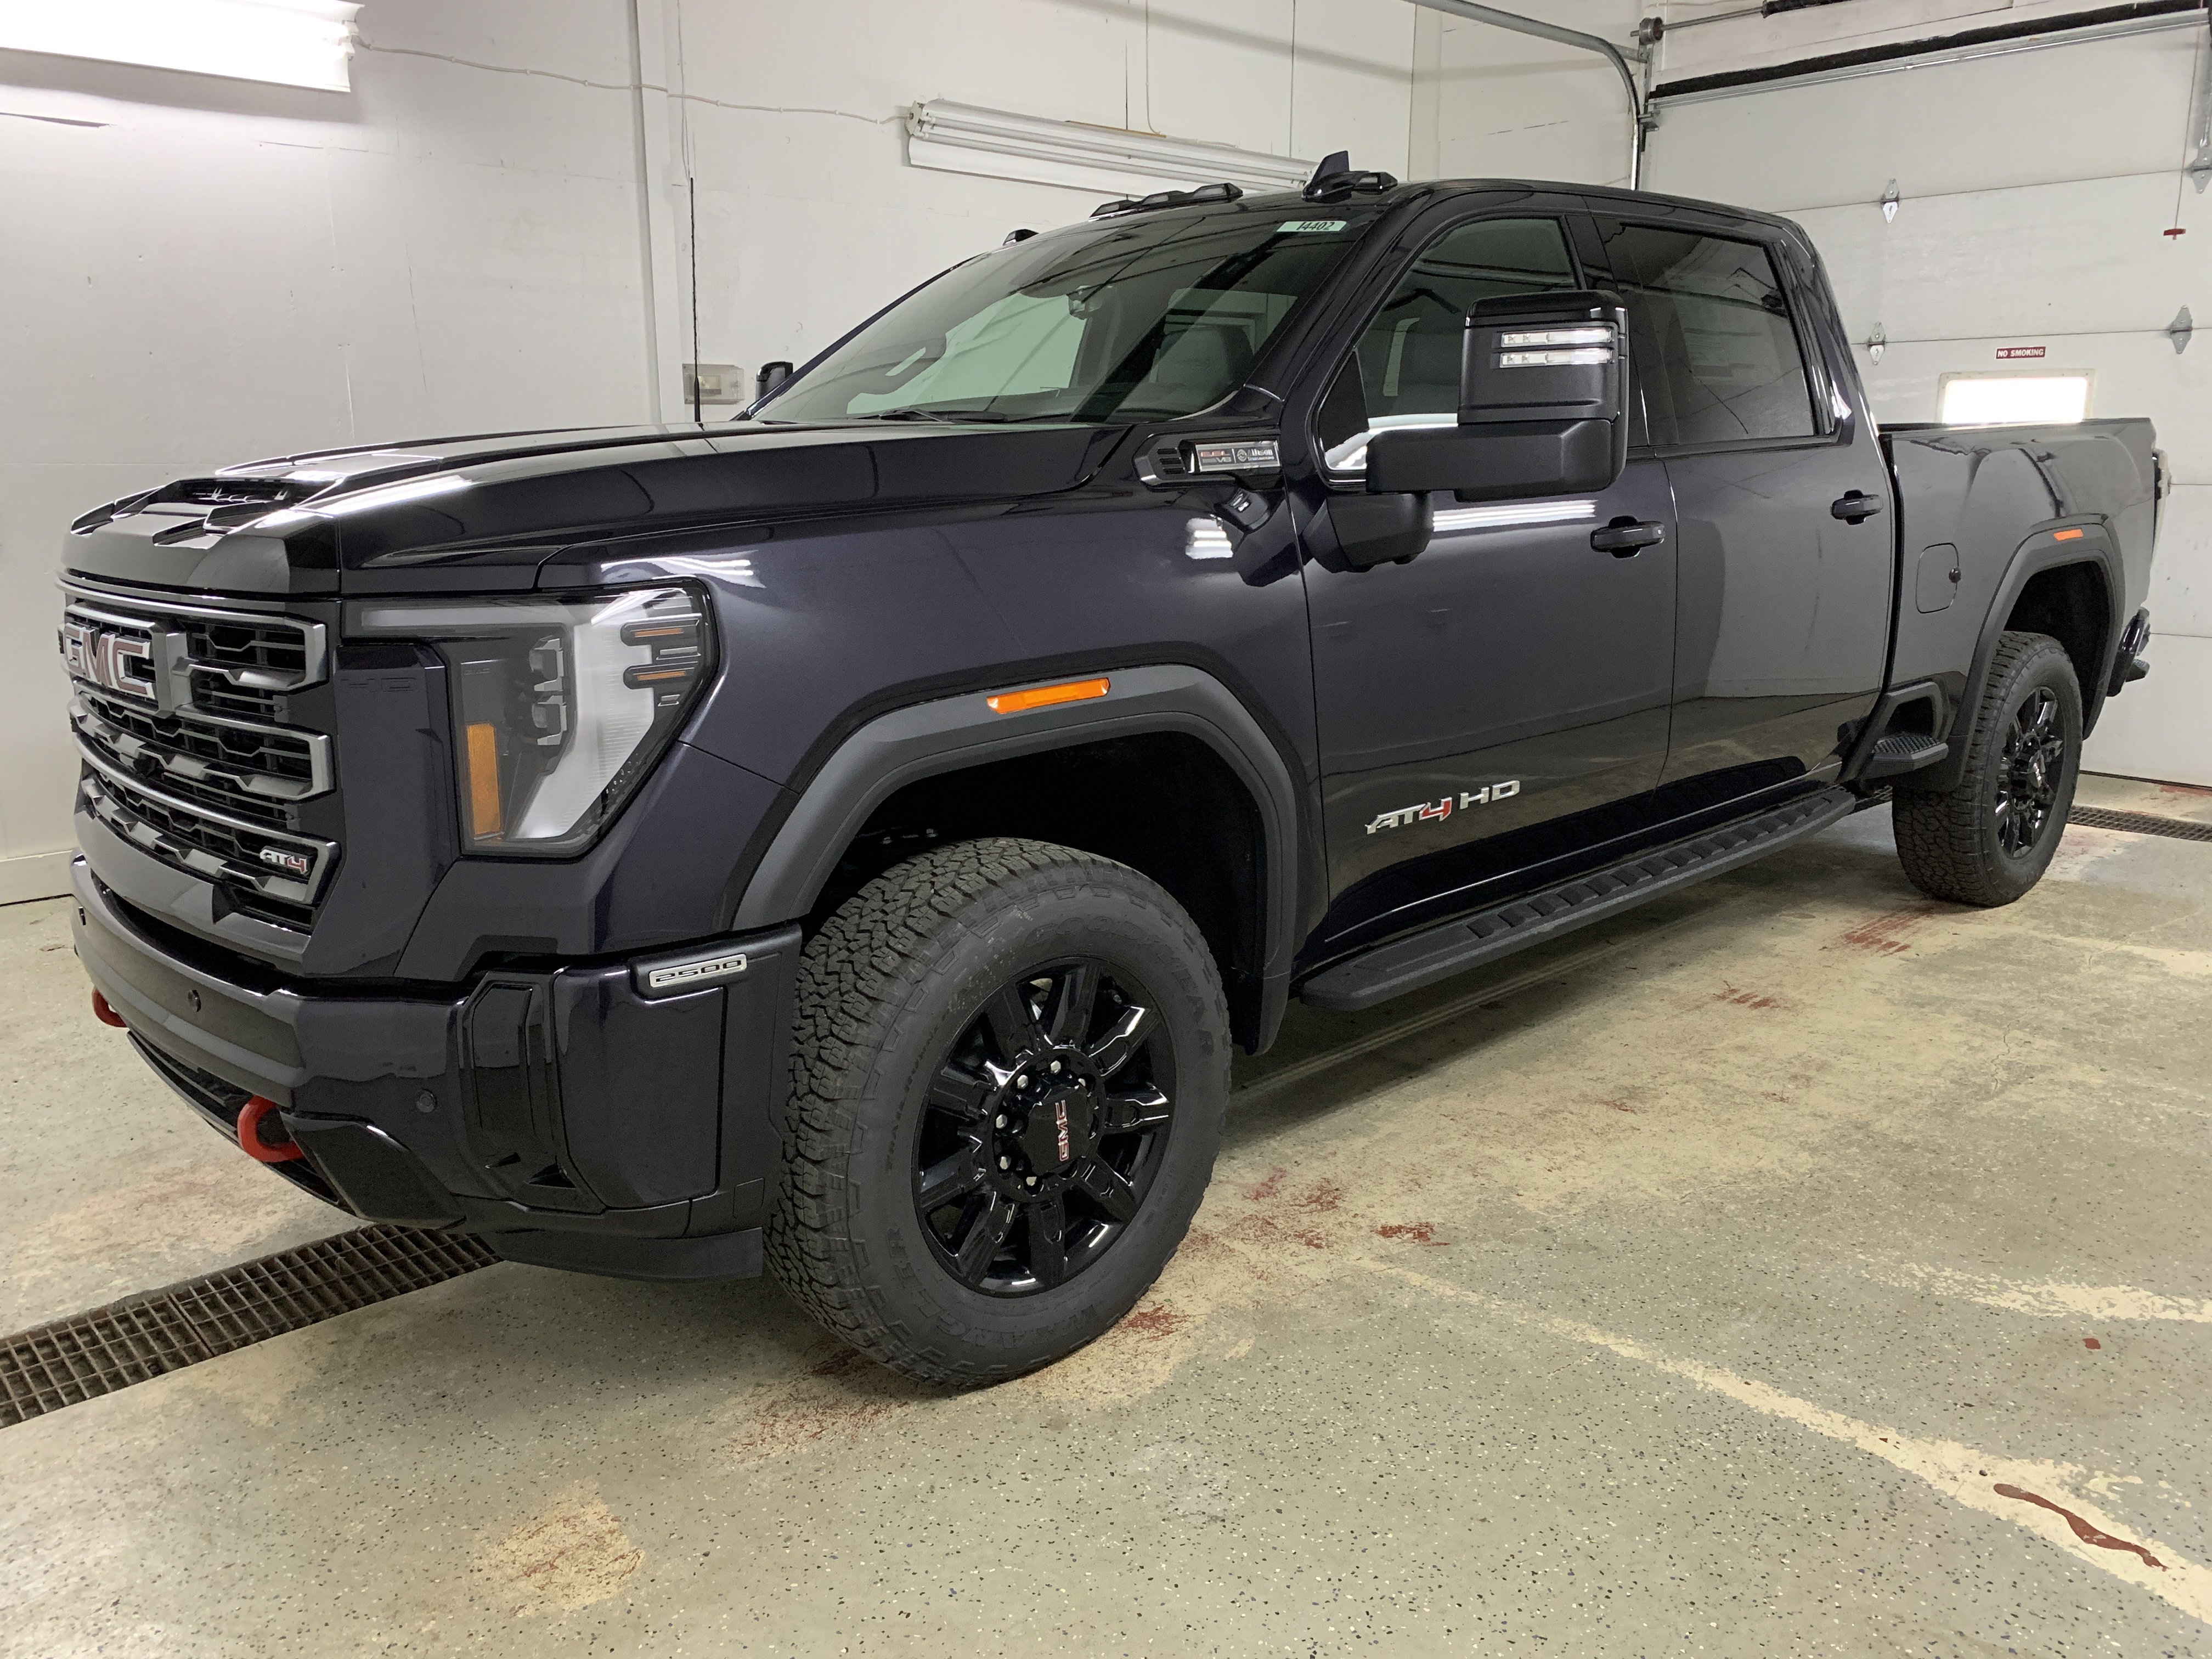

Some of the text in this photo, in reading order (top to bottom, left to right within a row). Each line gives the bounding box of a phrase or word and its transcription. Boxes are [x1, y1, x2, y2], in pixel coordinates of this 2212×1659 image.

[1296, 221, 1335, 230] 14402
[2010, 349, 2044, 357] SMOKING
[64, 622, 156, 700] GMC
[1364, 780, 1520, 834] AT4 HD
[259, 848, 307, 874] AT4
[655, 960, 742, 983] 2500
[1023, 916, 1215, 1056] GOODYEAR
[1054, 1099, 1070, 1162] GMC
